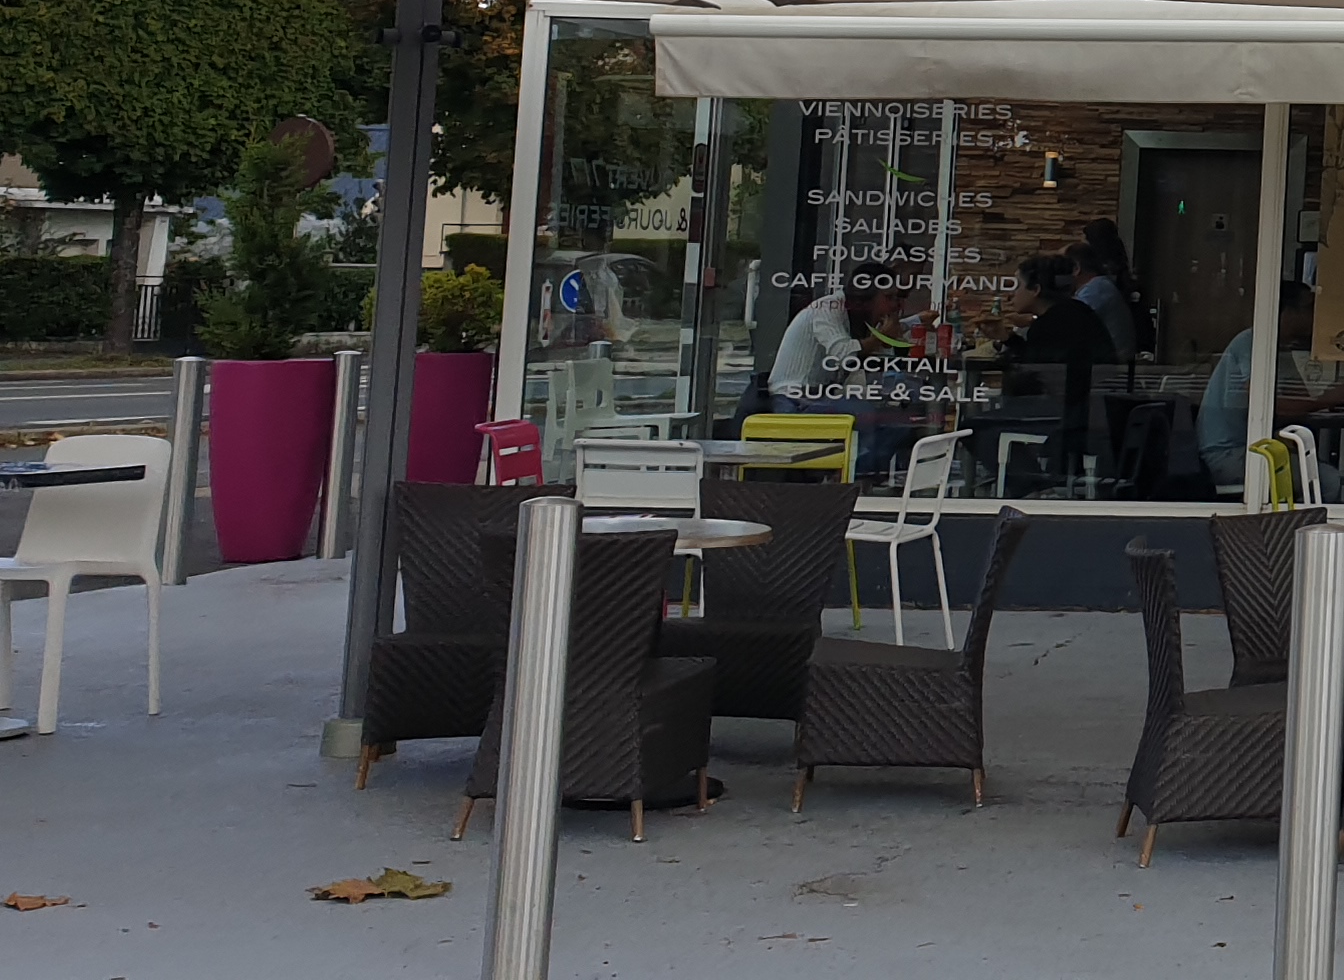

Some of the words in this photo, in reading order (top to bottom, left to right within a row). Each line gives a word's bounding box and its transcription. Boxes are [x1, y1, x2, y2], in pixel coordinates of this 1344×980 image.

[799, 101, 1012, 120] VIENNOISERIES
[807, 189, 993, 208] SANDWICHES
[834, 218, 962, 236] SALADES
[813, 245, 981, 264] FOUGASSES
[853, 273, 1019, 292] GOURMAND
[821, 355, 958, 374] COCKTAIL
[786, 380, 883, 401] SUCRÉ
[892, 382, 911, 401] &
[918, 382, 990, 403] SALÉ
